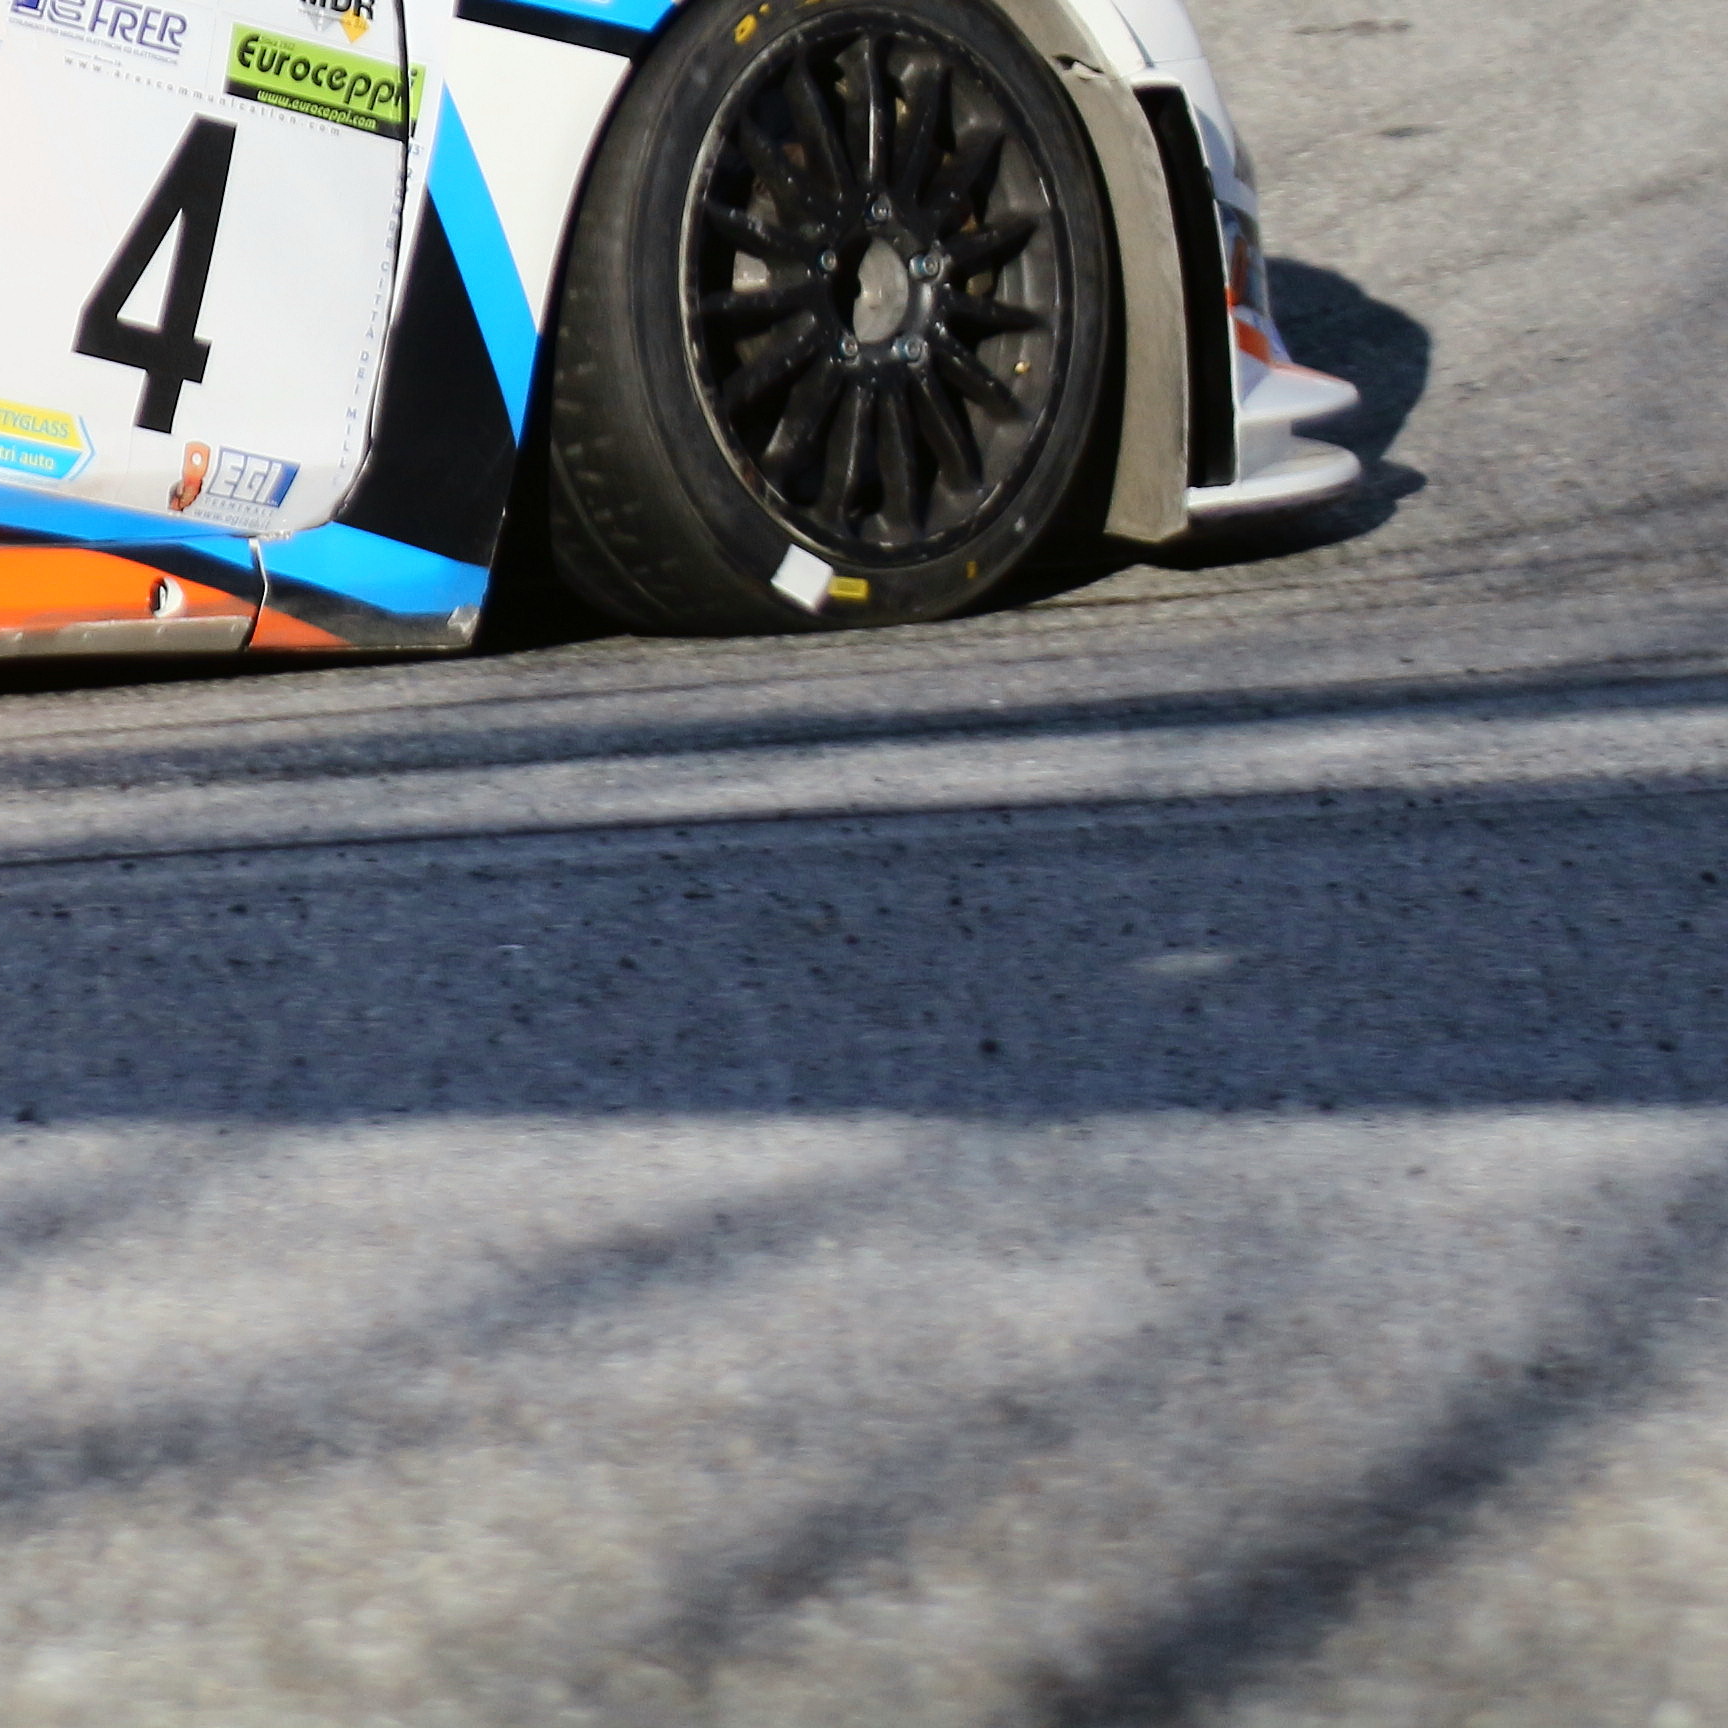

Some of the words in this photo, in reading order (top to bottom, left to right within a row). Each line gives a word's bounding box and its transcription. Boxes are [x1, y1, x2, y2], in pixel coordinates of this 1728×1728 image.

[236, 31, 419, 111] Euroceppi
[256, 88, 377, 130] www.euroceppi.com
[71, 111, 238, 435] 4
[354, 349, 370, 396] DEI
[18, 450, 56, 471] auto
[209, 450, 283, 504] EGI
